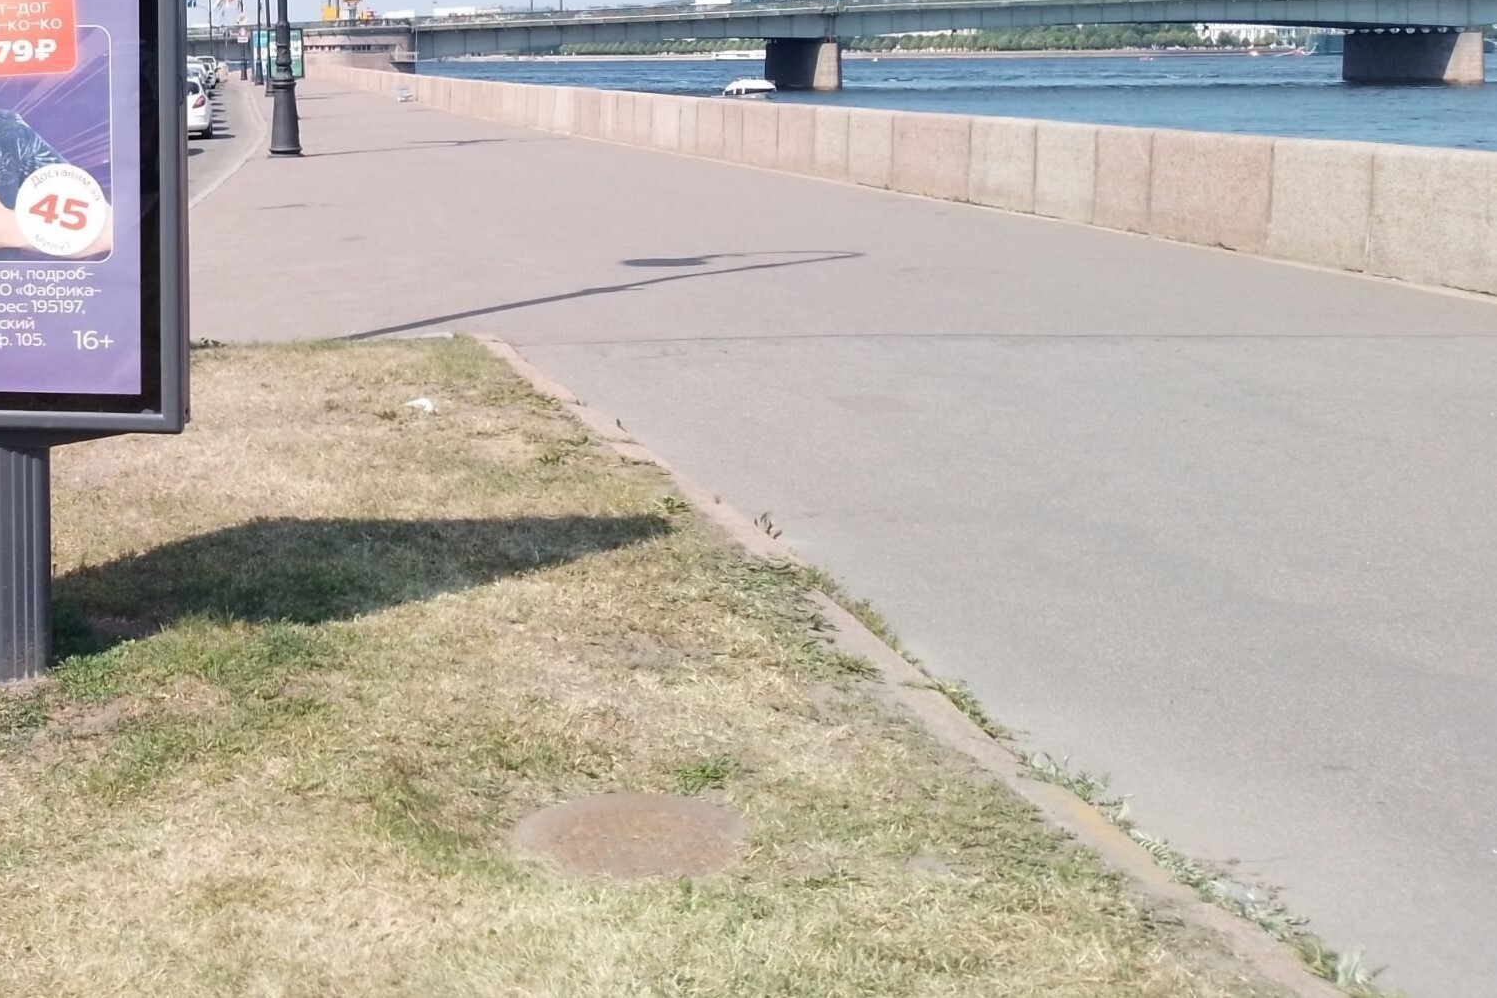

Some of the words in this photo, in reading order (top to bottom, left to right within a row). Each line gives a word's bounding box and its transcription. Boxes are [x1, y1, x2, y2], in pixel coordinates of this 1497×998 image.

[29, 193, 89, 231] 45
[26, 267, 95, 283] подроб-
[16, 283, 101, 299] «Фабрика-
[31, 300, 86, 315] 195197,
[15, 333, 47, 347] 105.
[72, 330, 115, 350] 16+
